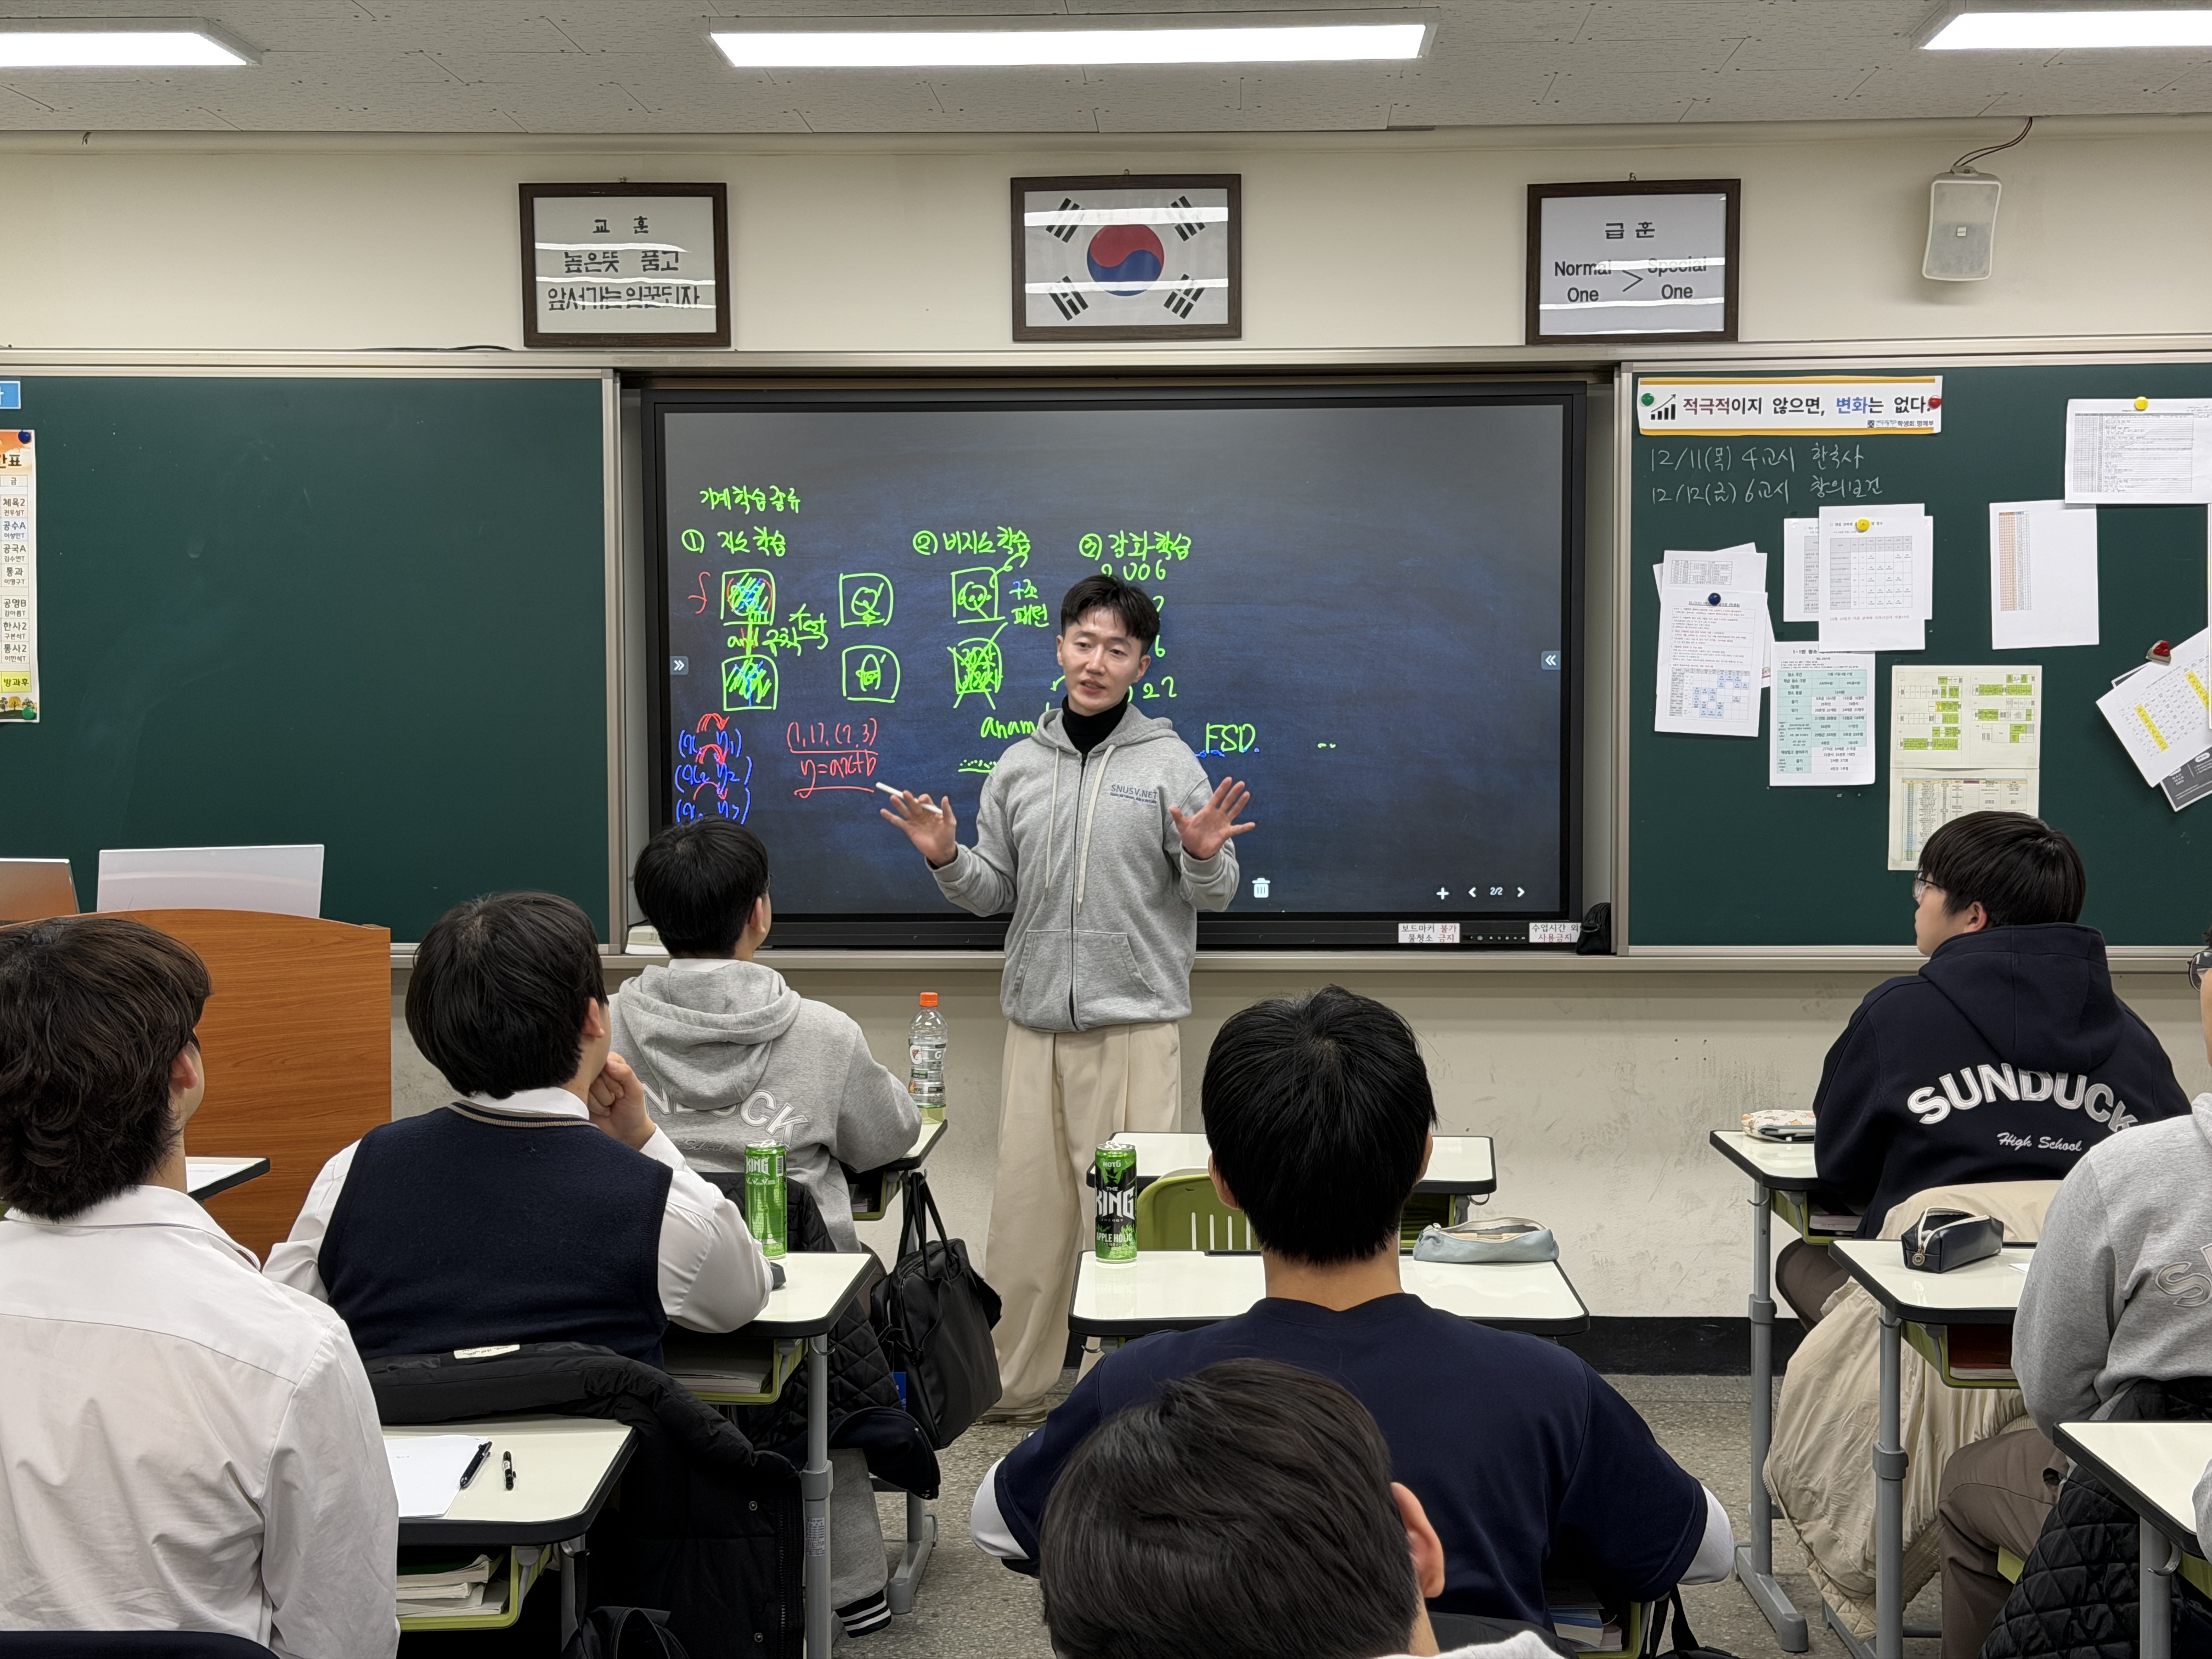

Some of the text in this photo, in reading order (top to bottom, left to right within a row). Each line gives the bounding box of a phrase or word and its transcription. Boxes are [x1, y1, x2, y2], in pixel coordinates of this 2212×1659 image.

[592, 216, 648, 234] 교 훈
[1605, 222, 1655, 239] 급 훈
[564, 250, 679, 273] 높은뜻 품고
[1554, 256, 1707, 277] Normal Special
[1567, 287, 1599, 302] One
[1661, 284, 1693, 300] One
[1683, 396, 1931, 417] 적극적이지 않으면, 변화는 없다.
[1651, 442, 1864, 473] 12/11(목) 4교시 한국사
[1652, 482, 1736, 506] 12/12(금)
[1745, 478, 1789, 504] 6교시
[3, 498, 25, 507] 체육2
[3, 521, 26, 531] 공수A
[3, 544, 26, 554] 공국A
[5, 567, 23, 577] 통과
[3, 599, 26, 608] 공영B
[3, 622, 27, 631] 한사2
[4, 644, 27, 654] 통사2
[3, 678, 29, 687] 방과후
[1111, 785, 1158, 799] SNUSV.NET
[1490, 887, 1503, 895] 2/2
[1402, 924, 1457, 933] 보드마커 불가
[1531, 924, 1566, 933] 수업시간
[1408, 934, 1454, 943] 물청소 금지
[1538, 933, 1572, 943] 사용금지
[1907, 1063, 2138, 1132] SUNDUCK
[1997, 1132, 2083, 1152] High School
[1114, 1232, 1132, 1243] HOLIC
